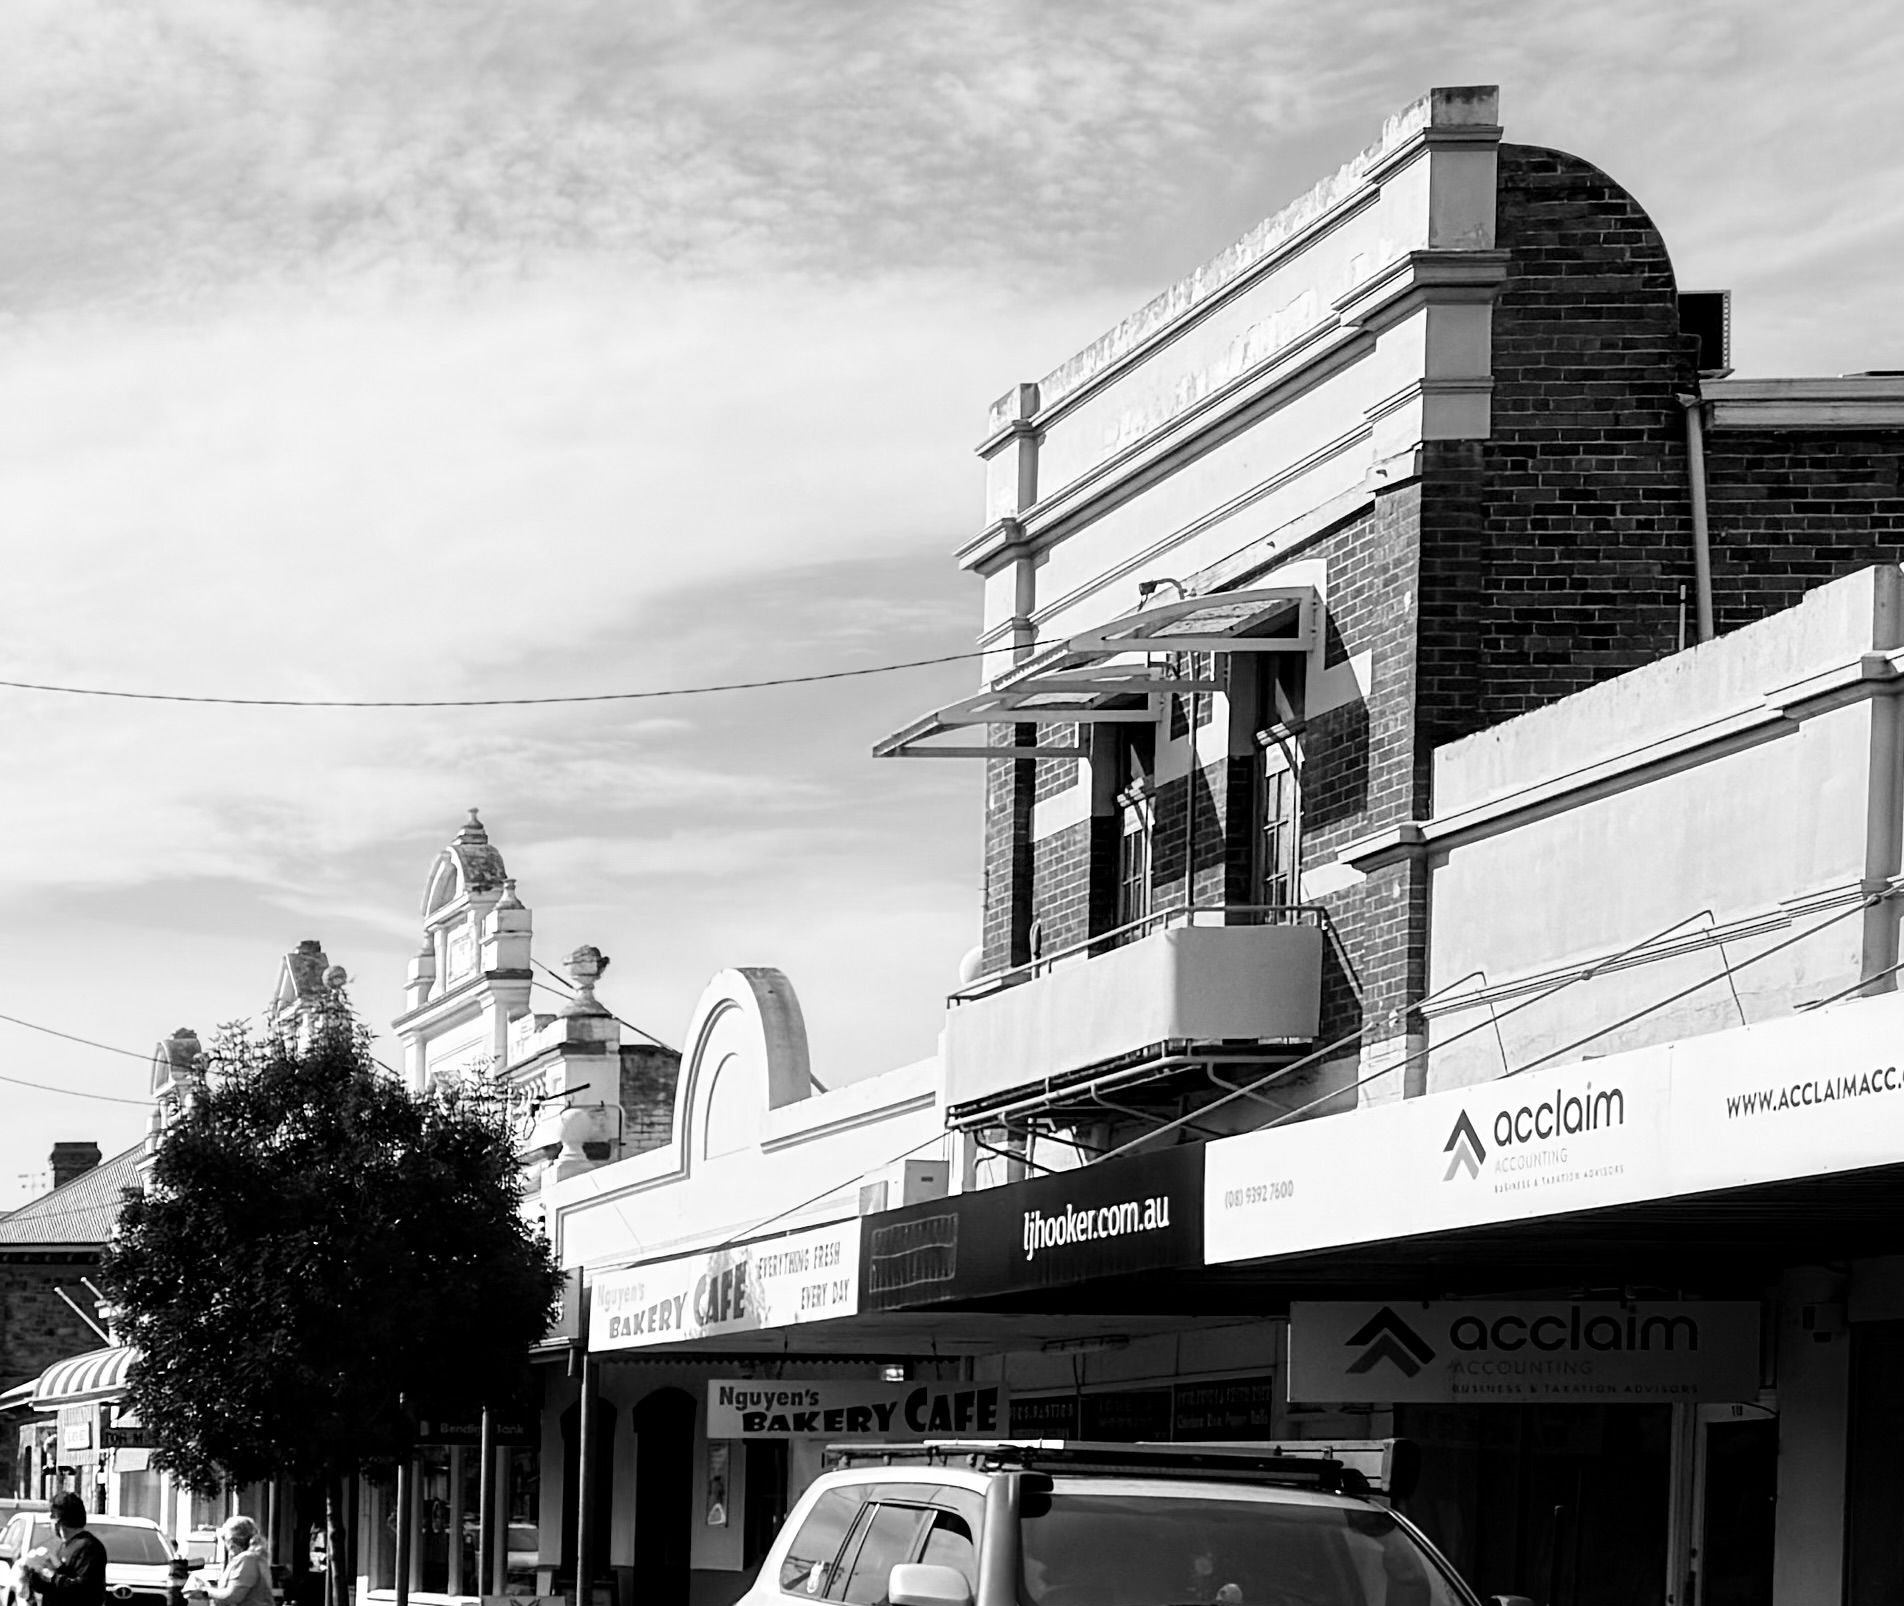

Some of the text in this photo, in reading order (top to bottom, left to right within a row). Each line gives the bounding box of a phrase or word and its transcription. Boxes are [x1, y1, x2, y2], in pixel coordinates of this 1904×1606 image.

[1727, 1066, 1904, 1119] WWW.ACCLAIMACC.
[1493, 1081, 1624, 1148] acclaim
[1495, 1148, 1569, 1174] ACCOUNTING
[1495, 1181, 1530, 1194] BUSINESS
[1542, 1171, 1581, 1186] TAXATION
[1583, 1164, 1624, 1180] ADVISORS
[1224, 1191, 1244, 1210] (08)
[1246, 1184, 1269, 1205] 9392
[1023, 1196, 1169, 1261] ljhooker.com.au
[759, 1241, 841, 1280] EVERYTHING FRESH
[597, 1283, 645, 1312] Nguyen's
[609, 1260, 748, 1339] BAKERY CAFE
[800, 1278, 850, 1310] EVERY DAY
[1449, 1305, 1699, 1351] acclaim
[1450, 1360, 1594, 1375] ACCOUNTING
[719, 1387, 819, 1411] Nguyen's
[1452, 1383, 1522, 1394] BUSINESS
[1544, 1383, 1616, 1394] TAXATION
[1624, 1383, 1699, 1394] ADVISORS
[742, 1387, 998, 1432] BAKERY CAFE
